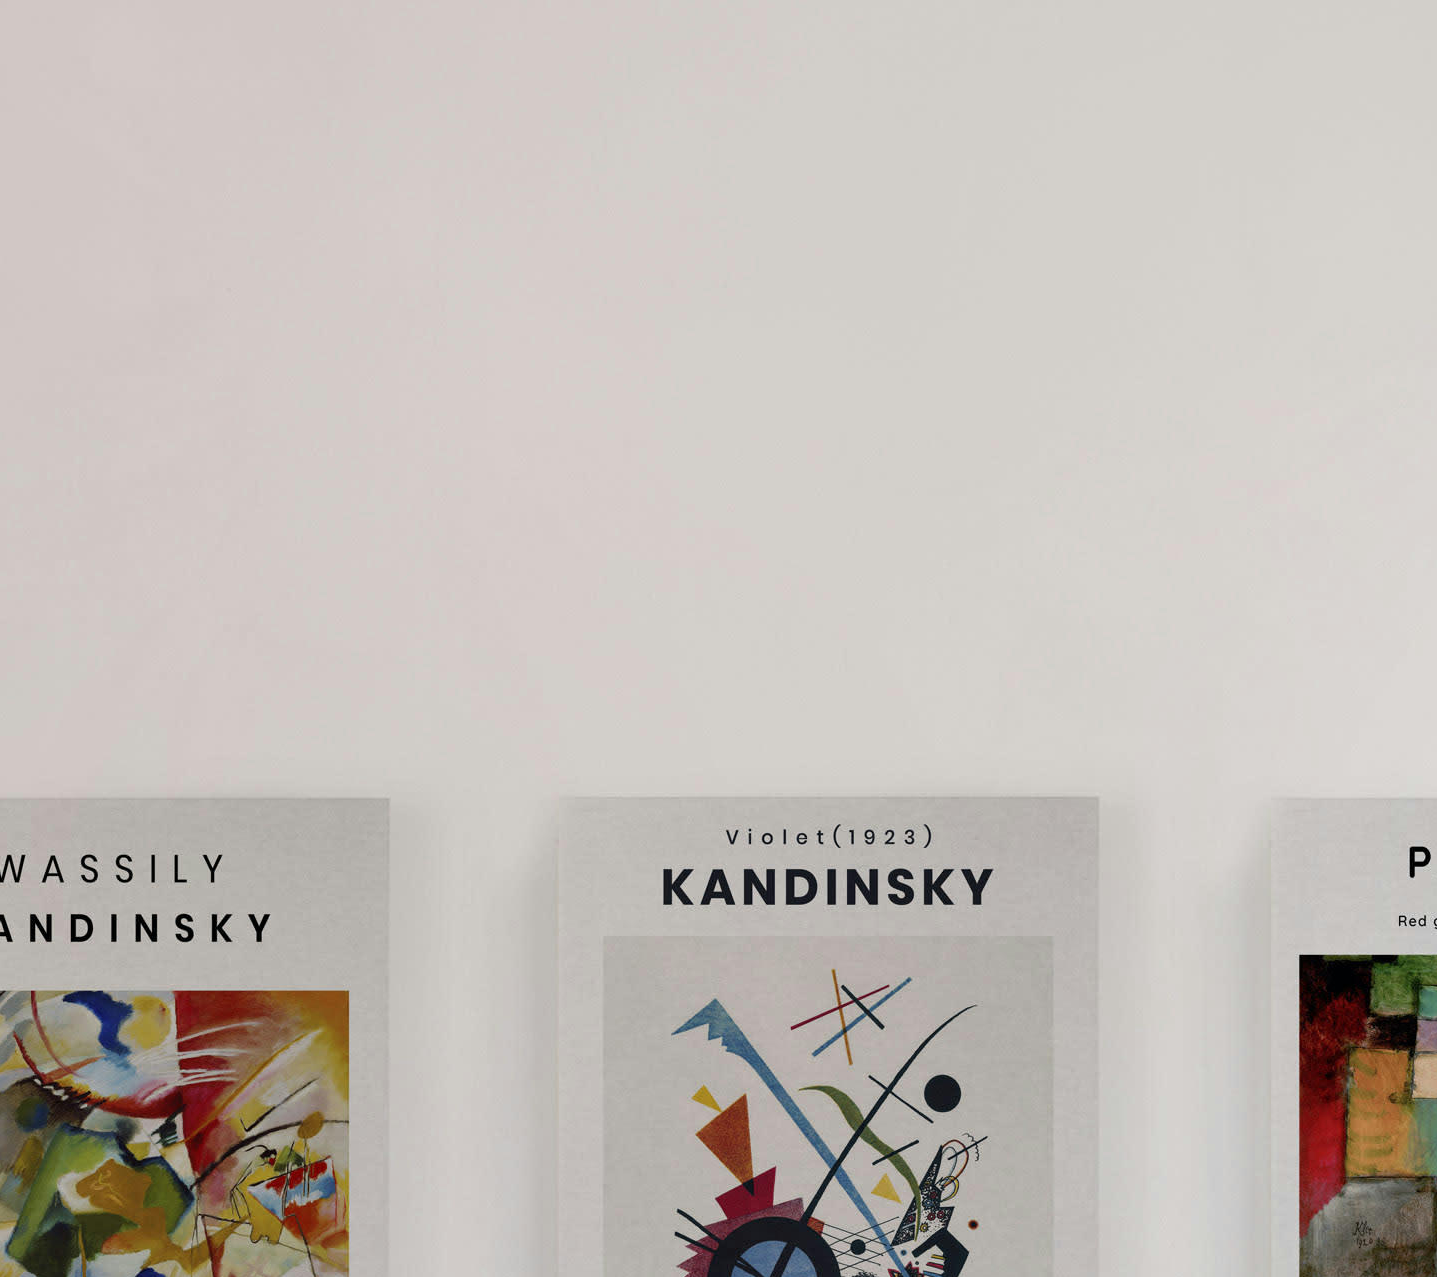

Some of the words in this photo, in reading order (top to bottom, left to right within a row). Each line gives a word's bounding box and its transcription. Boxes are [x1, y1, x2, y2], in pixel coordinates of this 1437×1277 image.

[725, 823, 932, 849] Violet(1923)
[662, 867, 994, 906] KANDINSKY
[1398, 914, 1427, 928] Red
